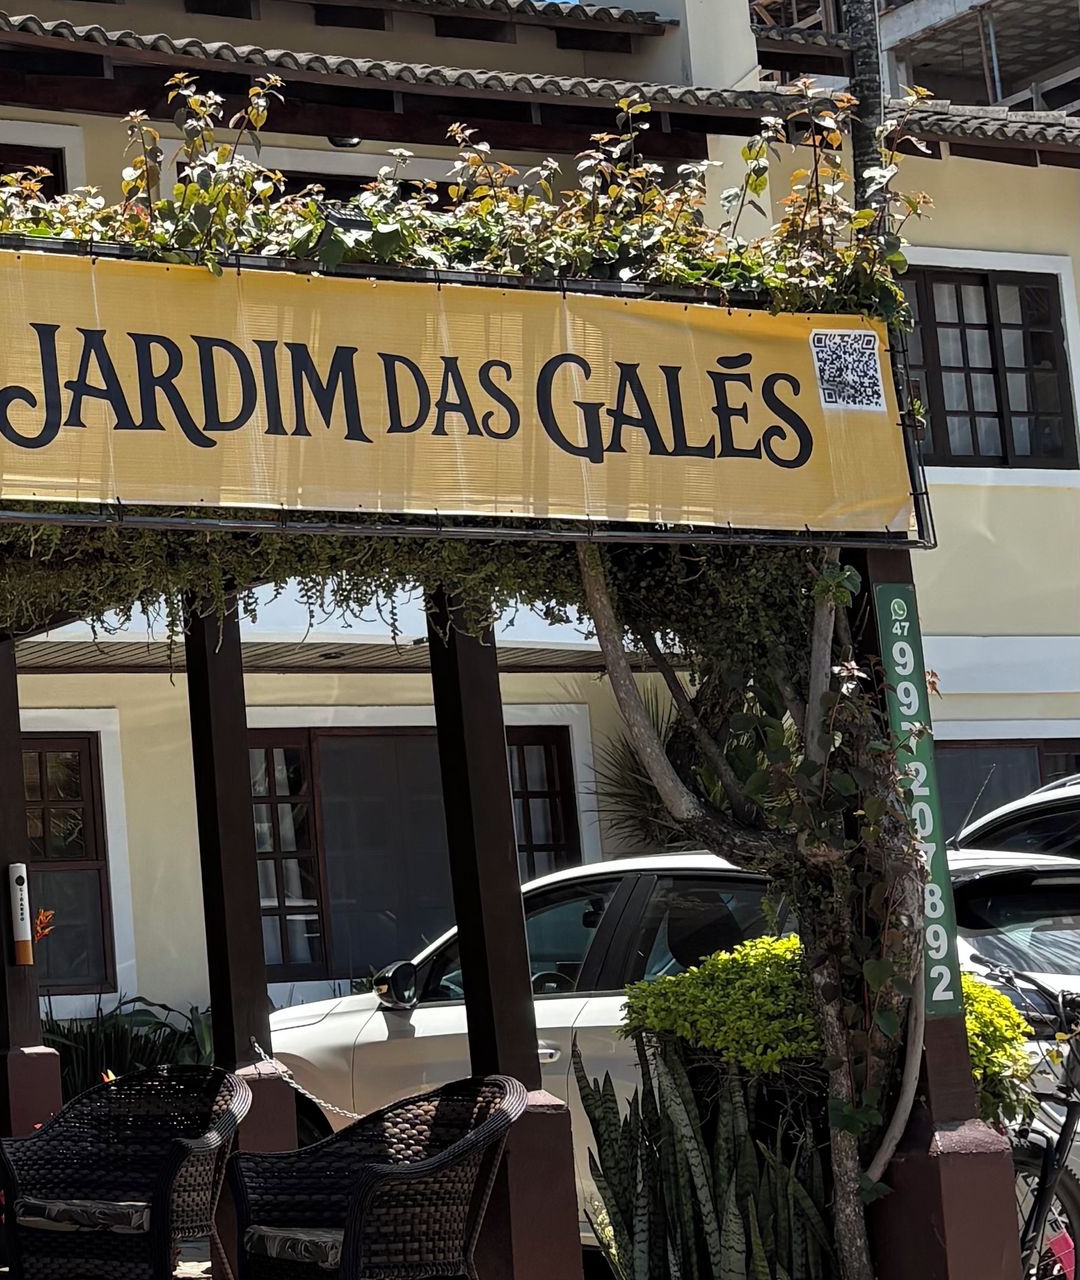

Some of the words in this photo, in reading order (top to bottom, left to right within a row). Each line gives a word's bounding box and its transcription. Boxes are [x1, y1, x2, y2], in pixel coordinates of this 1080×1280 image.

[377, 352, 521, 439] DAS
[536, 352, 814, 469] GALÉS
[892, 622, 910, 636] 47
